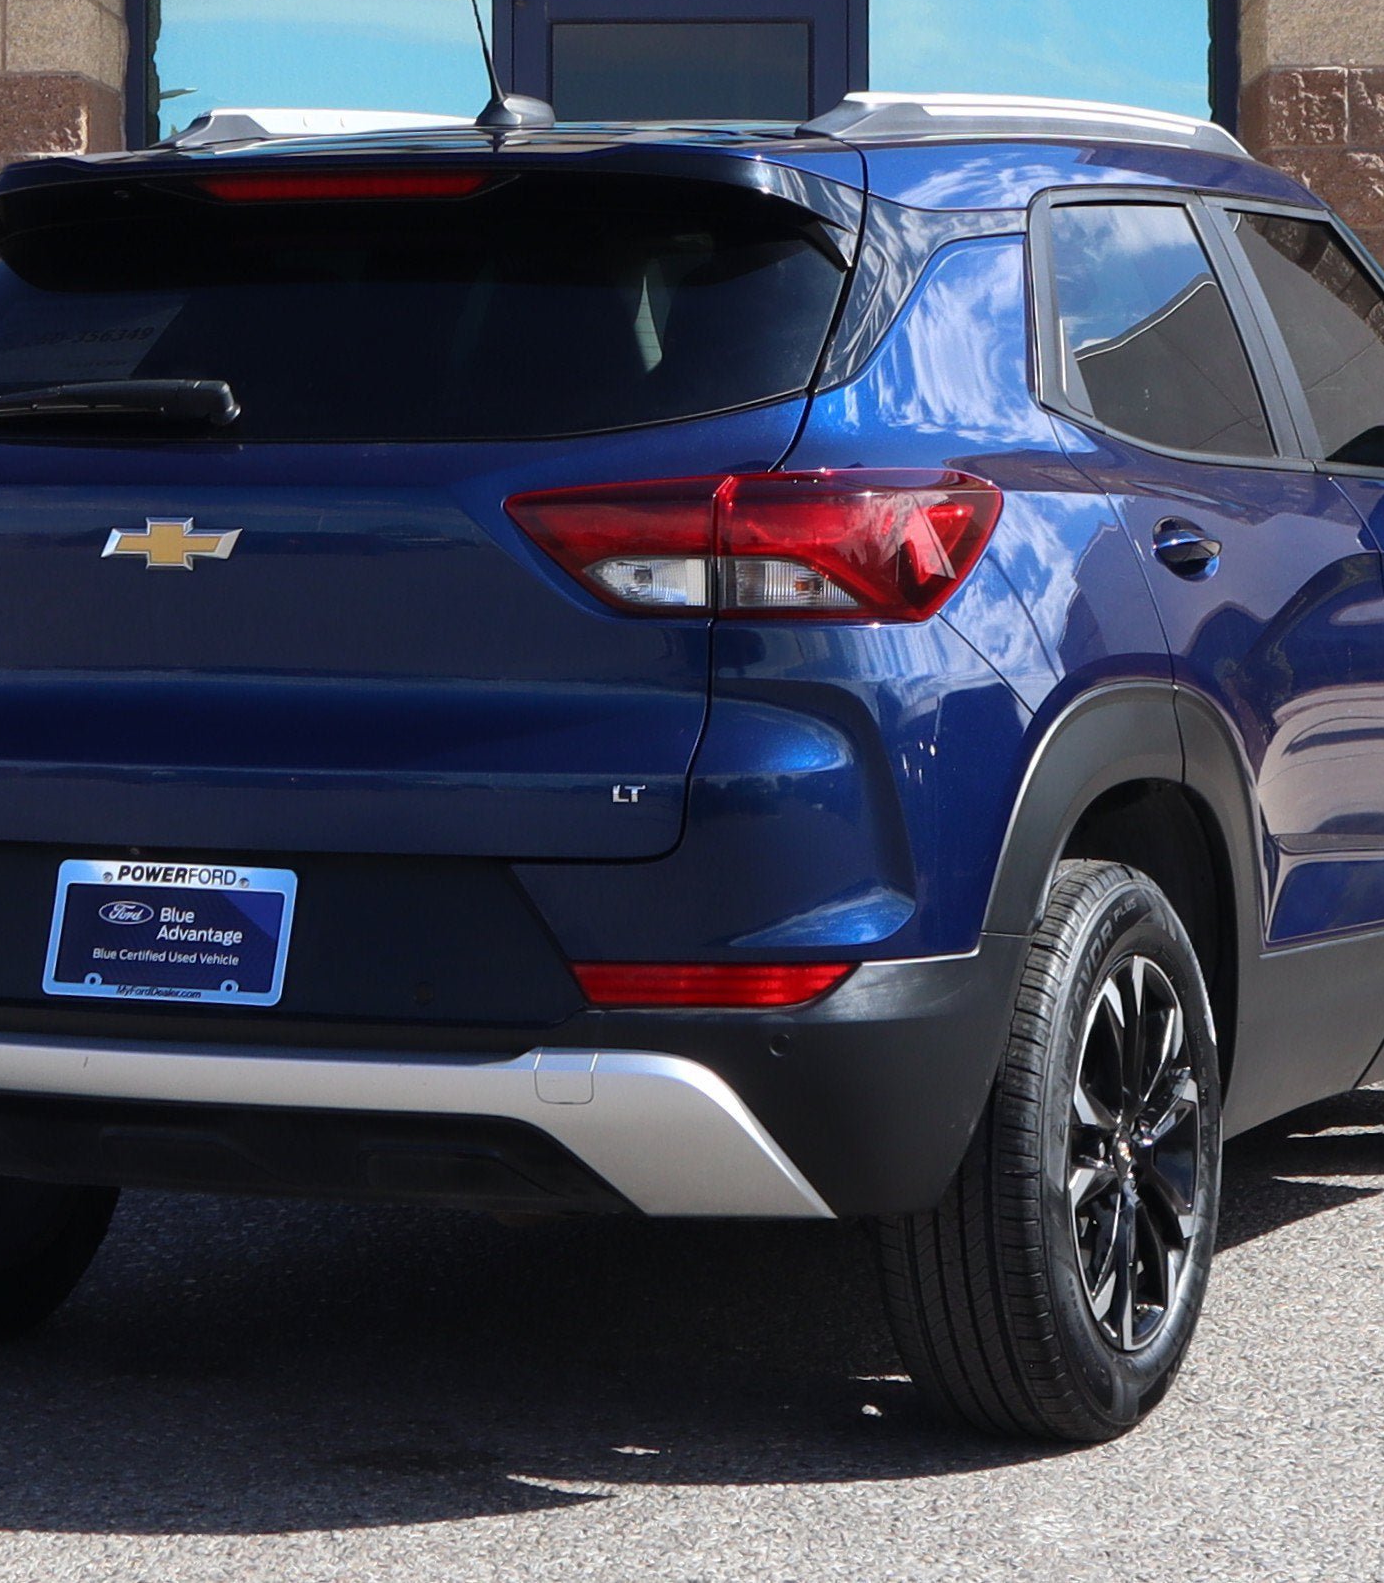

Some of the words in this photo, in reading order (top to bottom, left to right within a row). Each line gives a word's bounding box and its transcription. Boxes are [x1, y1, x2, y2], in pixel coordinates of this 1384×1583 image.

[612, 784, 646, 803] LT
[117, 865, 237, 886] POWERFORD
[160, 907, 195, 923] Blue
[1115, 897, 1138, 921] PLUS
[156, 925, 243, 946] Advantage
[93, 948, 117, 960] Blue
[119, 948, 166, 963] Certified
[168, 951, 196, 964] Used
[199, 953, 239, 966] Vehicle
